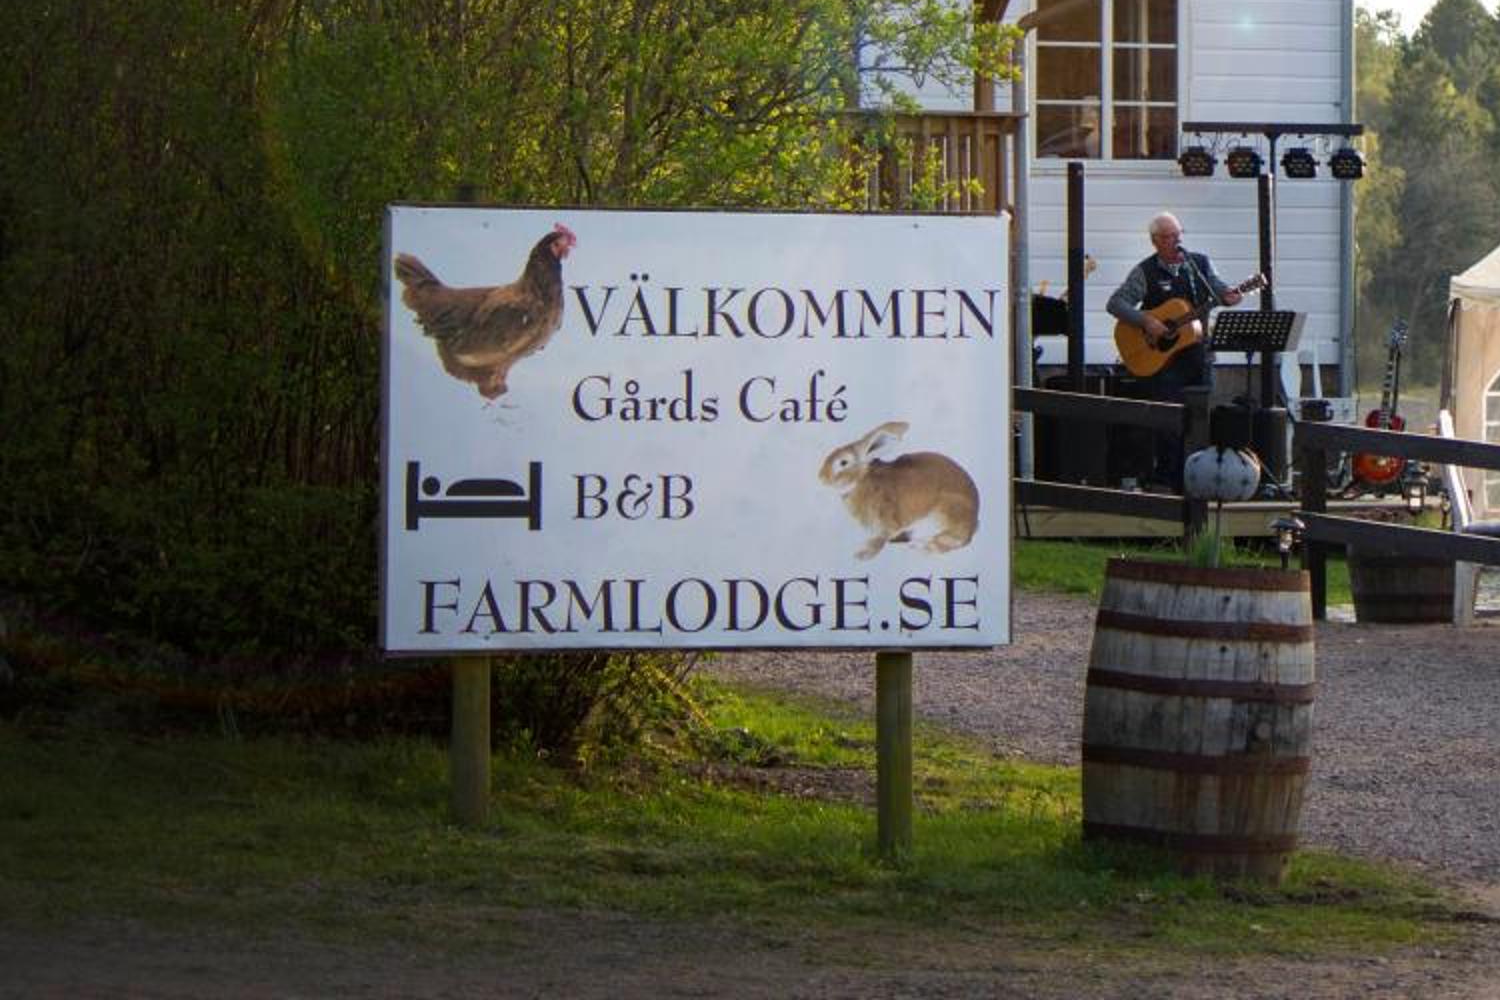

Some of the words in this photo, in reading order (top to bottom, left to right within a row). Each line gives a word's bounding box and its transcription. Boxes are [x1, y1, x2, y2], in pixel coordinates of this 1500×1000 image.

[569, 273, 1000, 340] VÄLKOMMEN
[572, 369, 720, 423] Gårds
[739, 369, 849, 423] Café
[573, 473, 695, 521] B&B
[418, 575, 982, 635] FARMLODGE.SE
